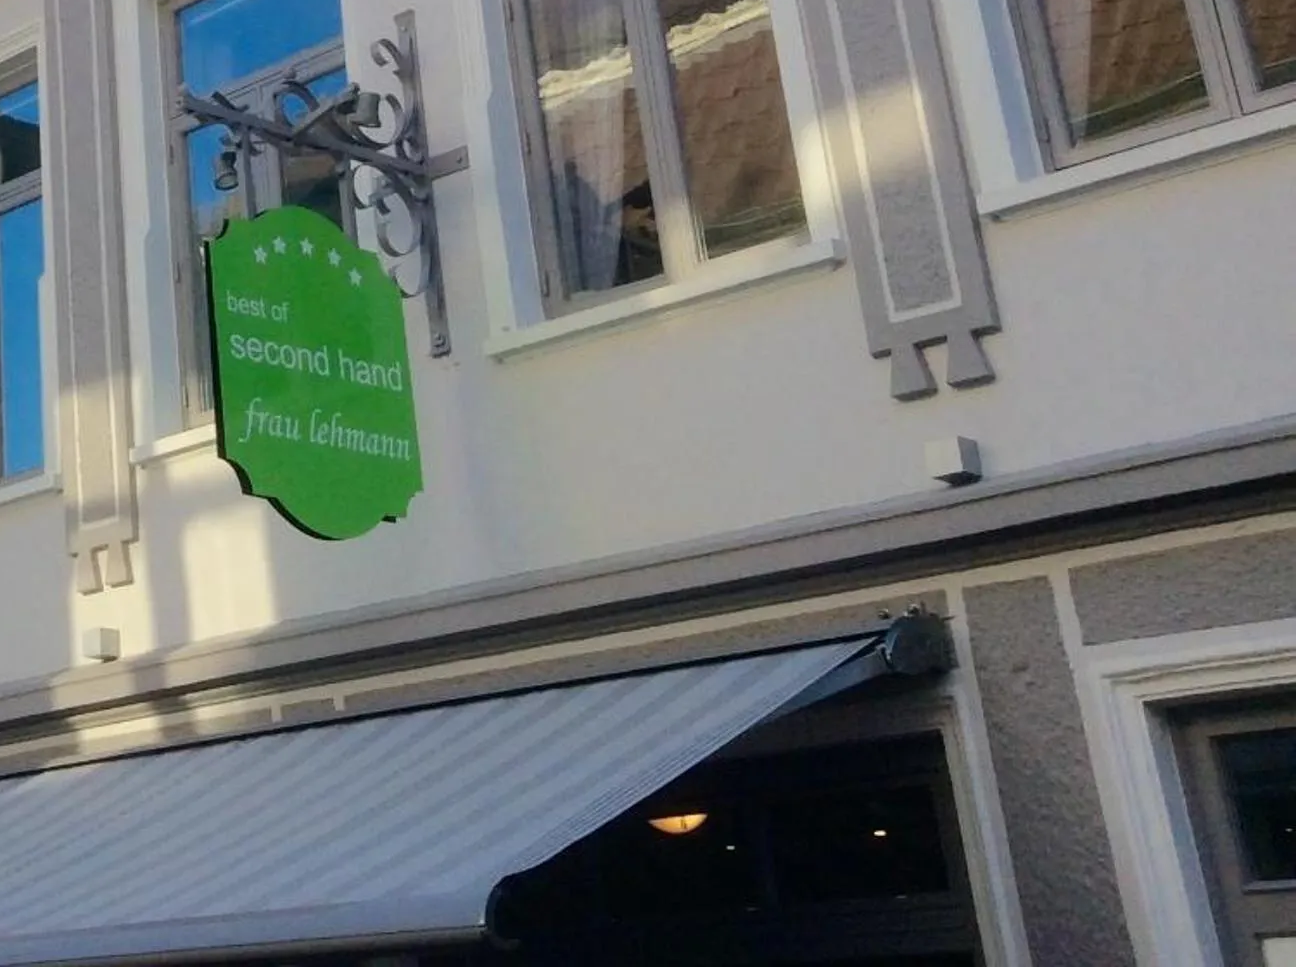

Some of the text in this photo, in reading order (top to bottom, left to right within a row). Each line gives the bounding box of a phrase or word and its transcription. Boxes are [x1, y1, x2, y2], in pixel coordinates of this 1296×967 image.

[226, 289, 289, 323] best of
[230, 333, 403, 392] second hand
[238, 397, 410, 462] frau lehmann
